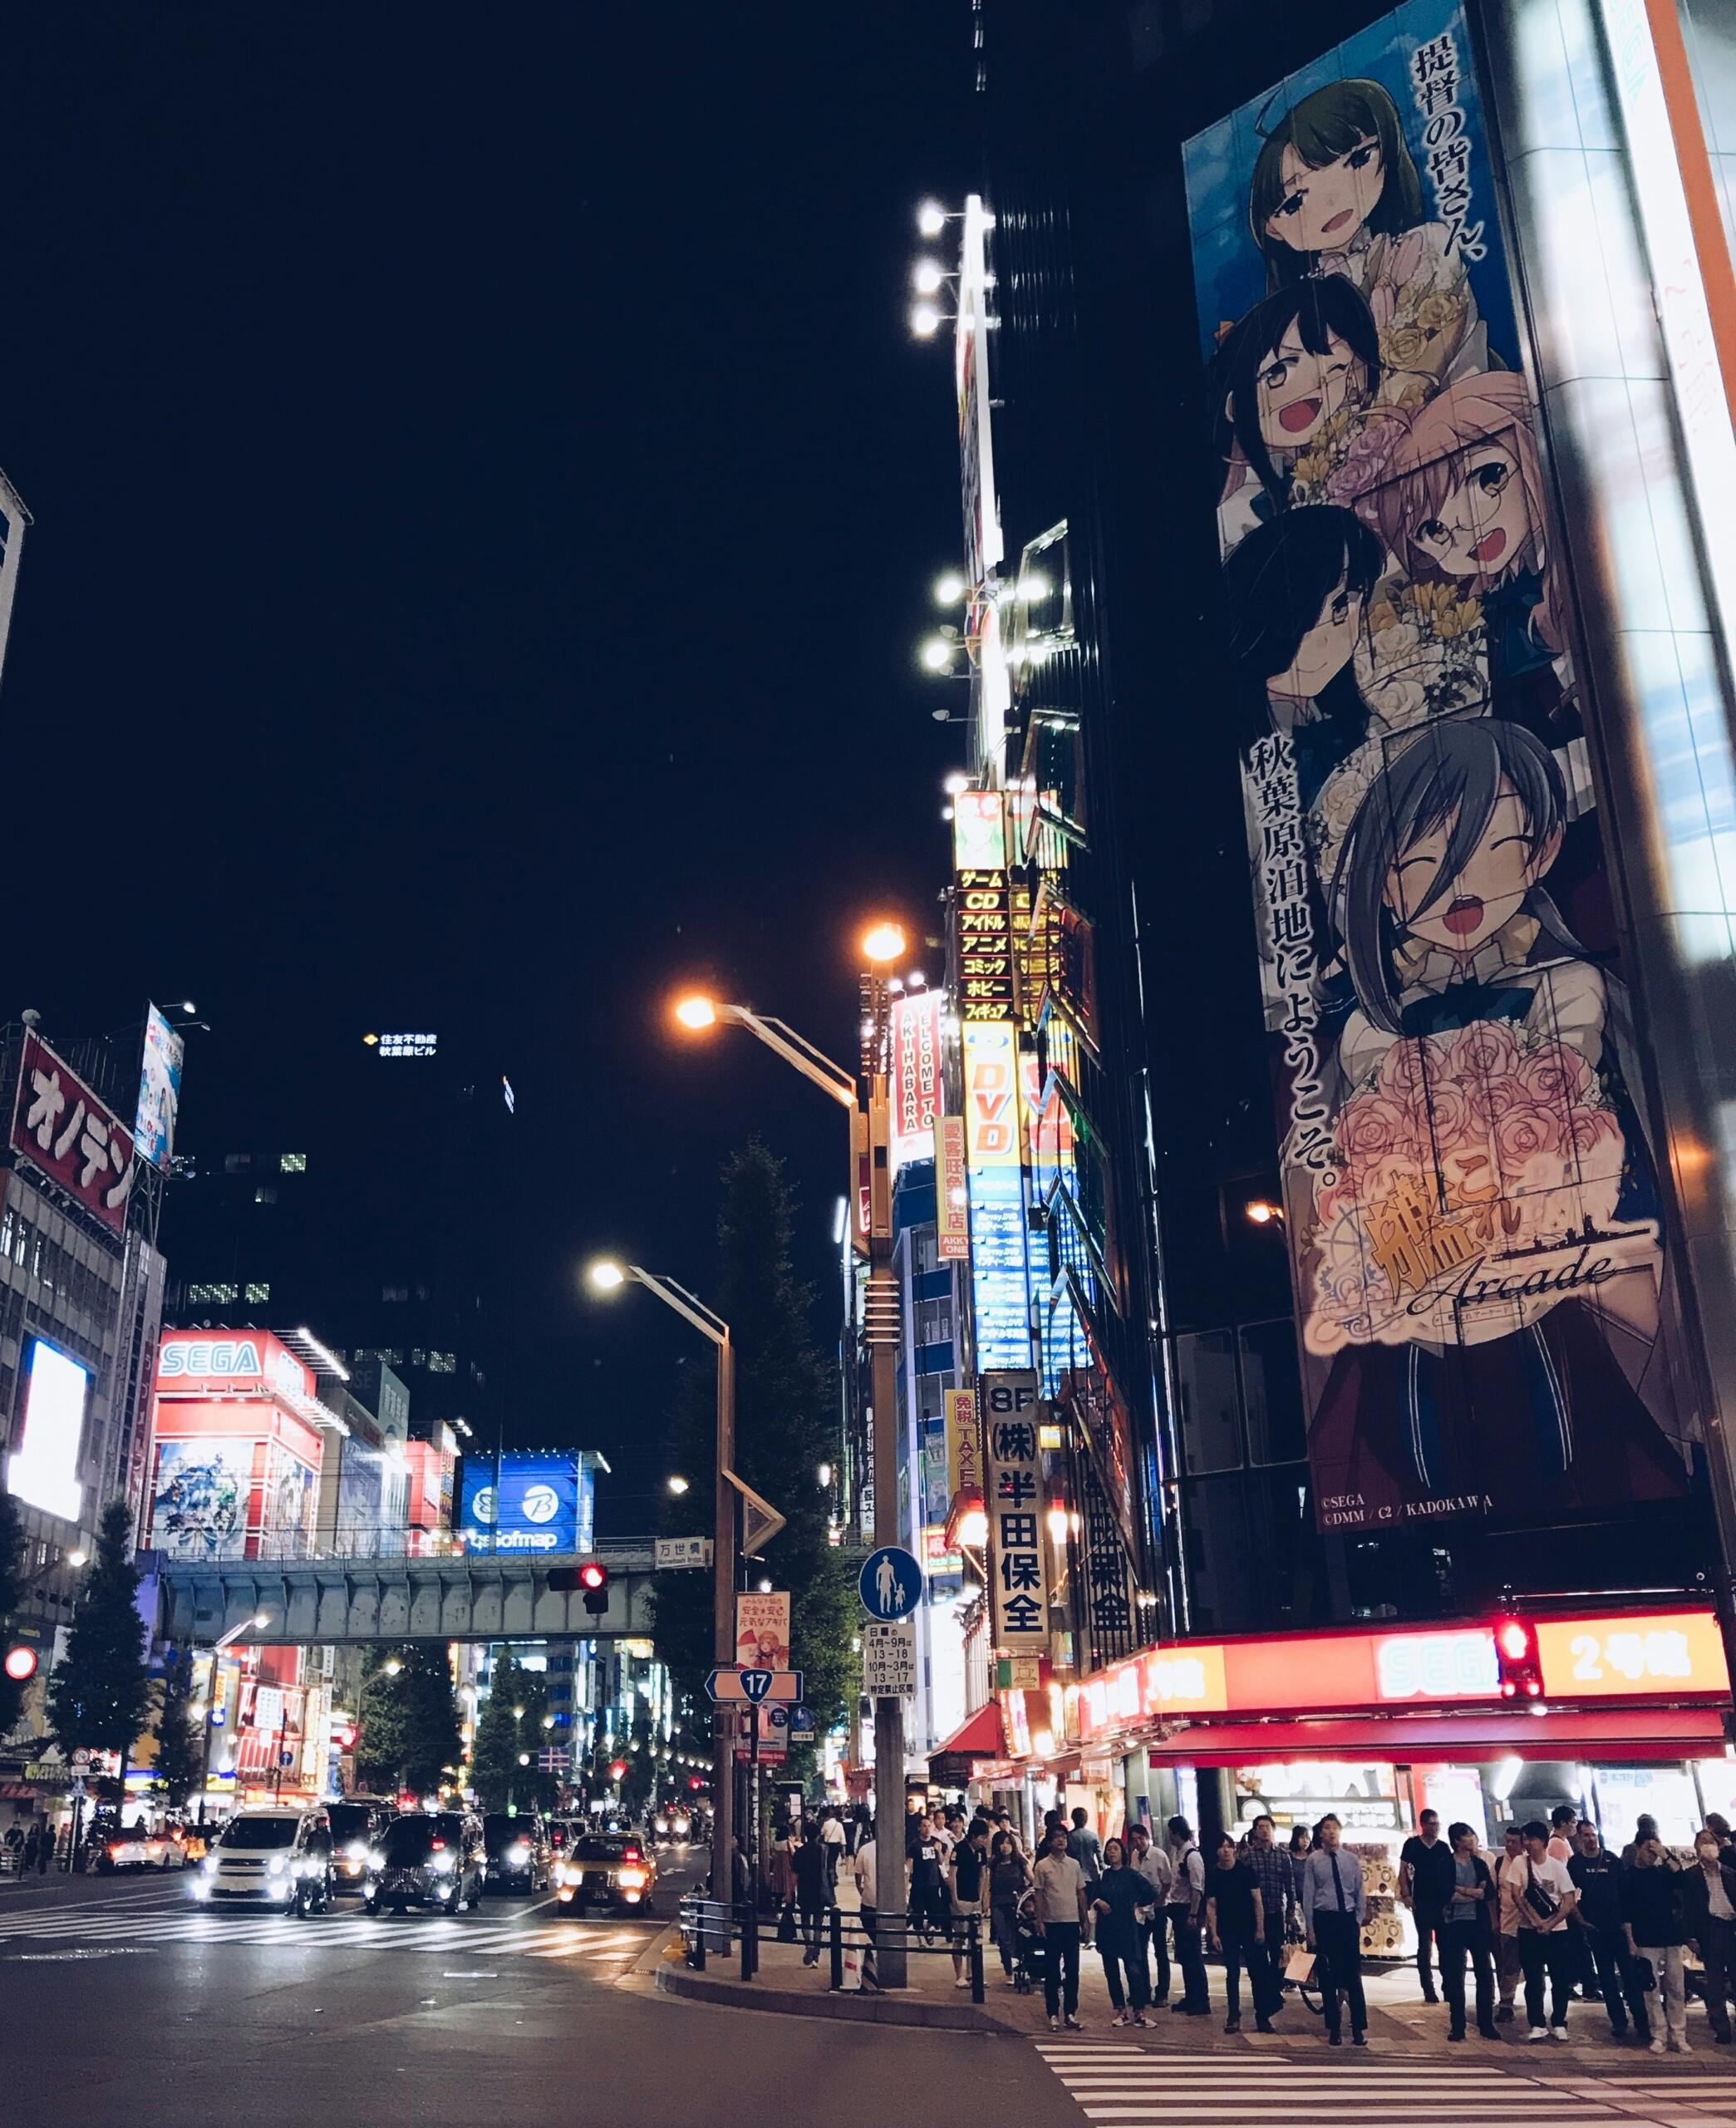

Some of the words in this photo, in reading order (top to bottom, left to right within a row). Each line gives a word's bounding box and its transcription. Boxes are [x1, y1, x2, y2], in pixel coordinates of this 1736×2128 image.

[1414, 35, 1484, 258] 提督の皆さん、
[961, 872, 1002, 888] ゲーム
[966, 894, 1000, 910] CD
[961, 915, 1006, 932] アイドル
[962, 937, 1006, 953] アニメ
[964, 958, 1006, 975] コミック
[1251, 736, 1336, 1187] 秋葉原泊地にようこそ。
[966, 980, 1006, 998] ホビー
[966, 1002, 1008, 1020] フィギュア
[380, 1033, 438, 1046] 住友不動産
[379, 1045, 437, 1057] 秋葉原ビル
[902, 1014, 917, 1131] AKIHABARA
[923, 1099, 934, 1126] TO
[972, 1062, 1014, 1154] DVD
[27, 1067, 135, 1209] オノデン
[945, 1244, 969, 1254] ONE
[1406, 1246, 1615, 1316] Arcade
[162, 1342, 262, 1376] SEGA
[955, 1394, 973, 1424] 免税
[990, 1387, 1034, 1413] 8F
[1378, 1506, 1393, 1520] C2
[494, 1530, 558, 1551] ofmap
[1379, 1636, 1500, 1697] SEG
[746, 1674, 768, 1695] 17
